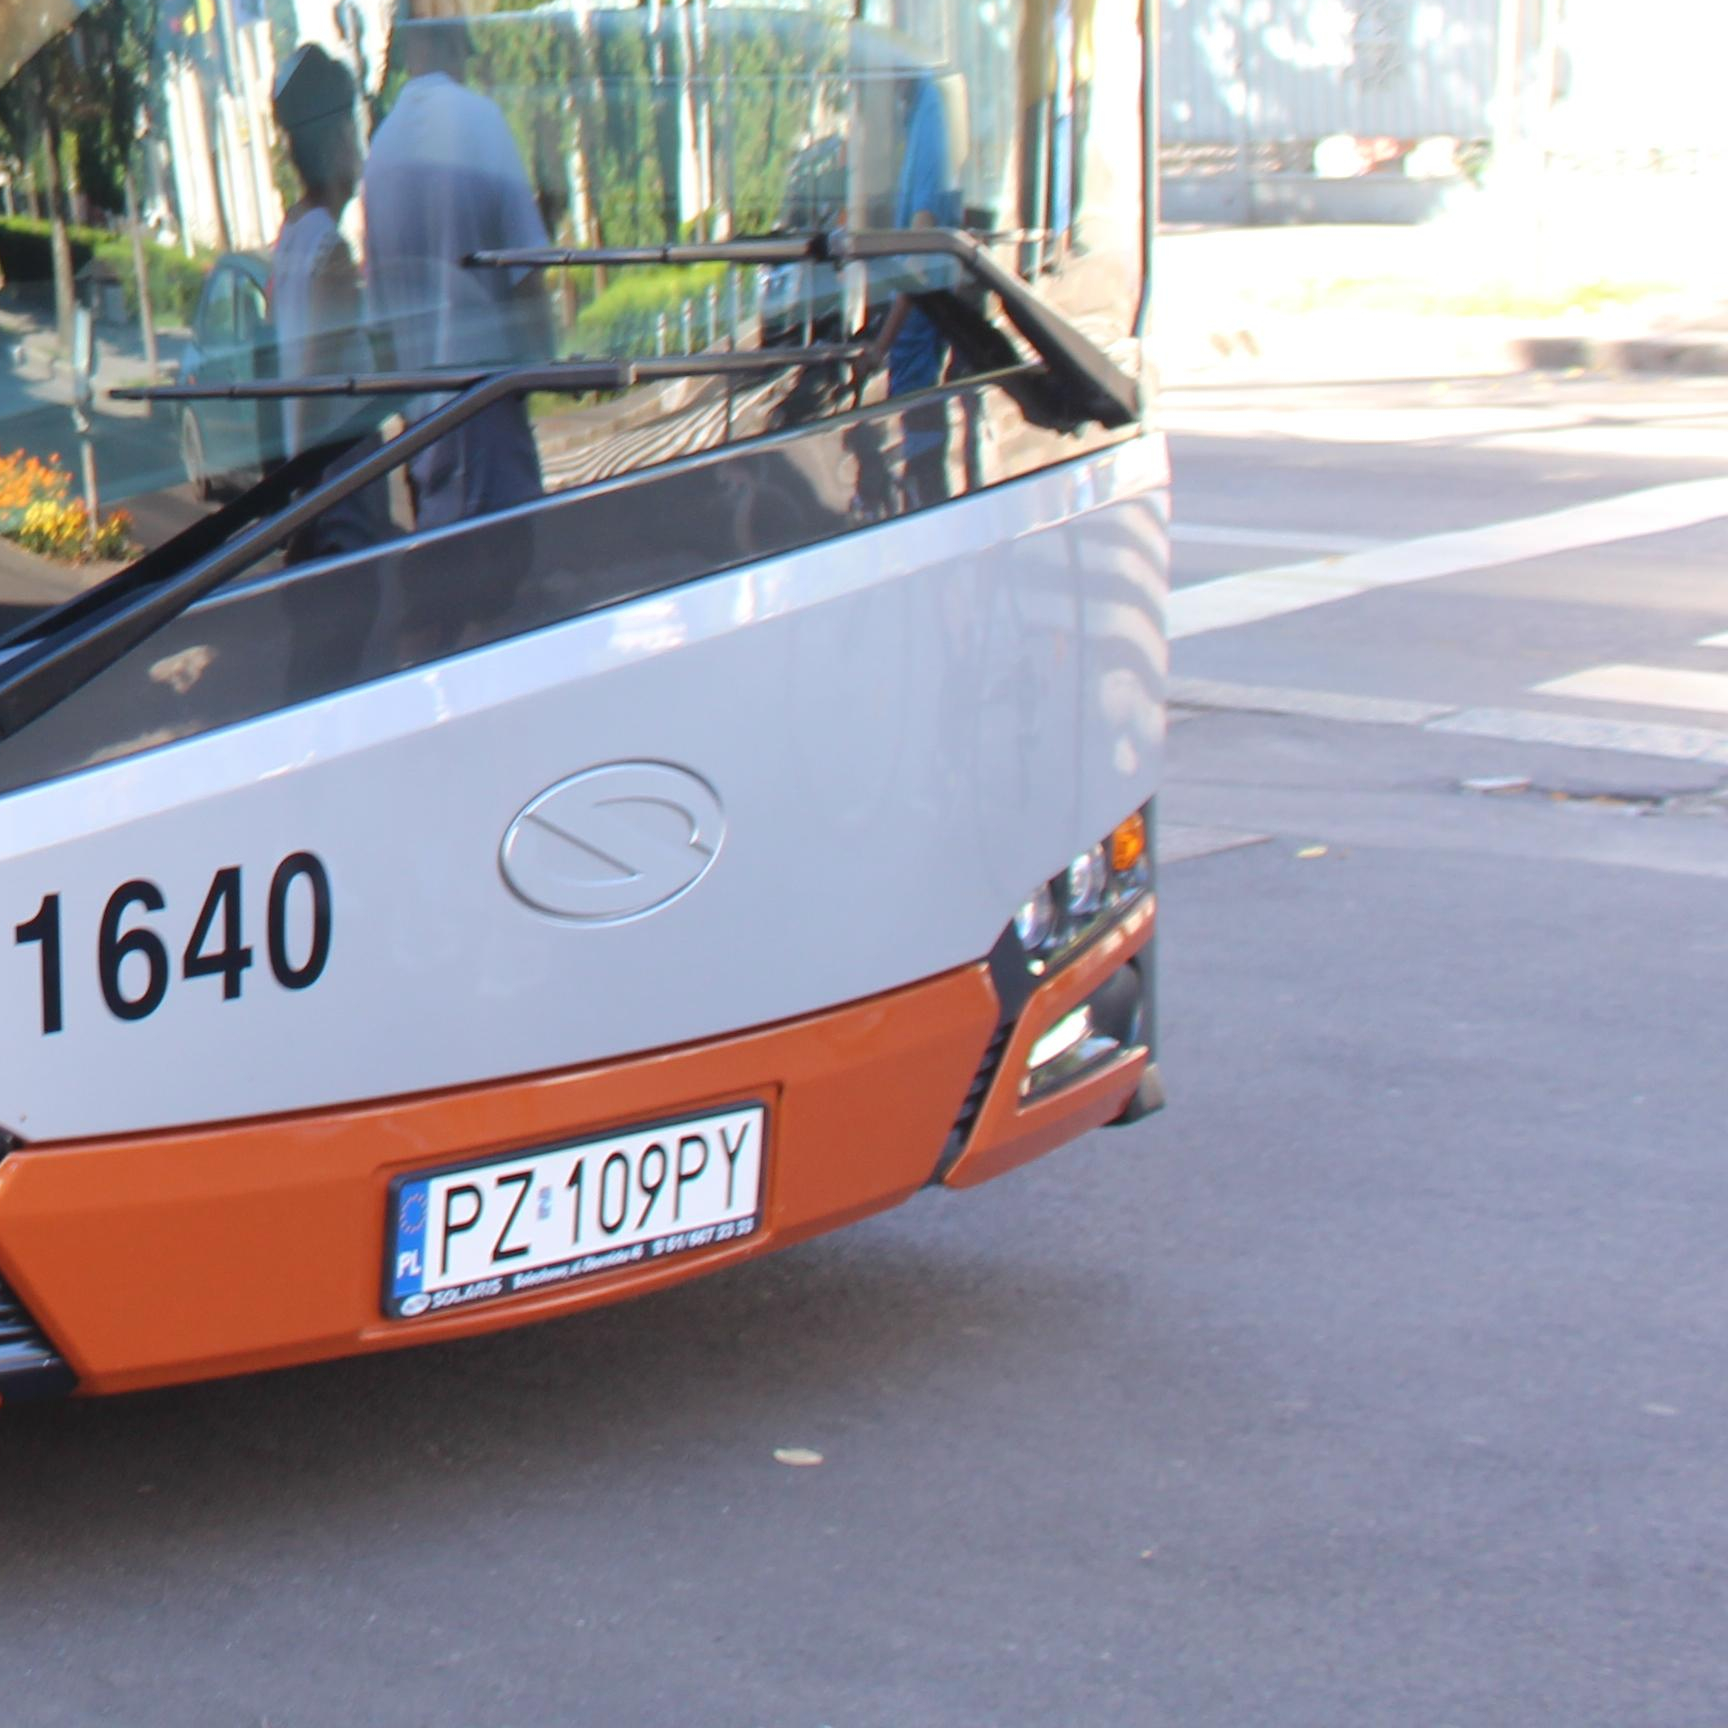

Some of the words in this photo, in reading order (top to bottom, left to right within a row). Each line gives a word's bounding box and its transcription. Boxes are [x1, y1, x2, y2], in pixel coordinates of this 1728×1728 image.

[14, 849, 333, 1036] 1640
[439, 1168, 536, 1277] PZ
[564, 1121, 754, 1246] 109PY
[397, 1249, 422, 1278] PL
[429, 1278, 503, 1310] SOLARIS
